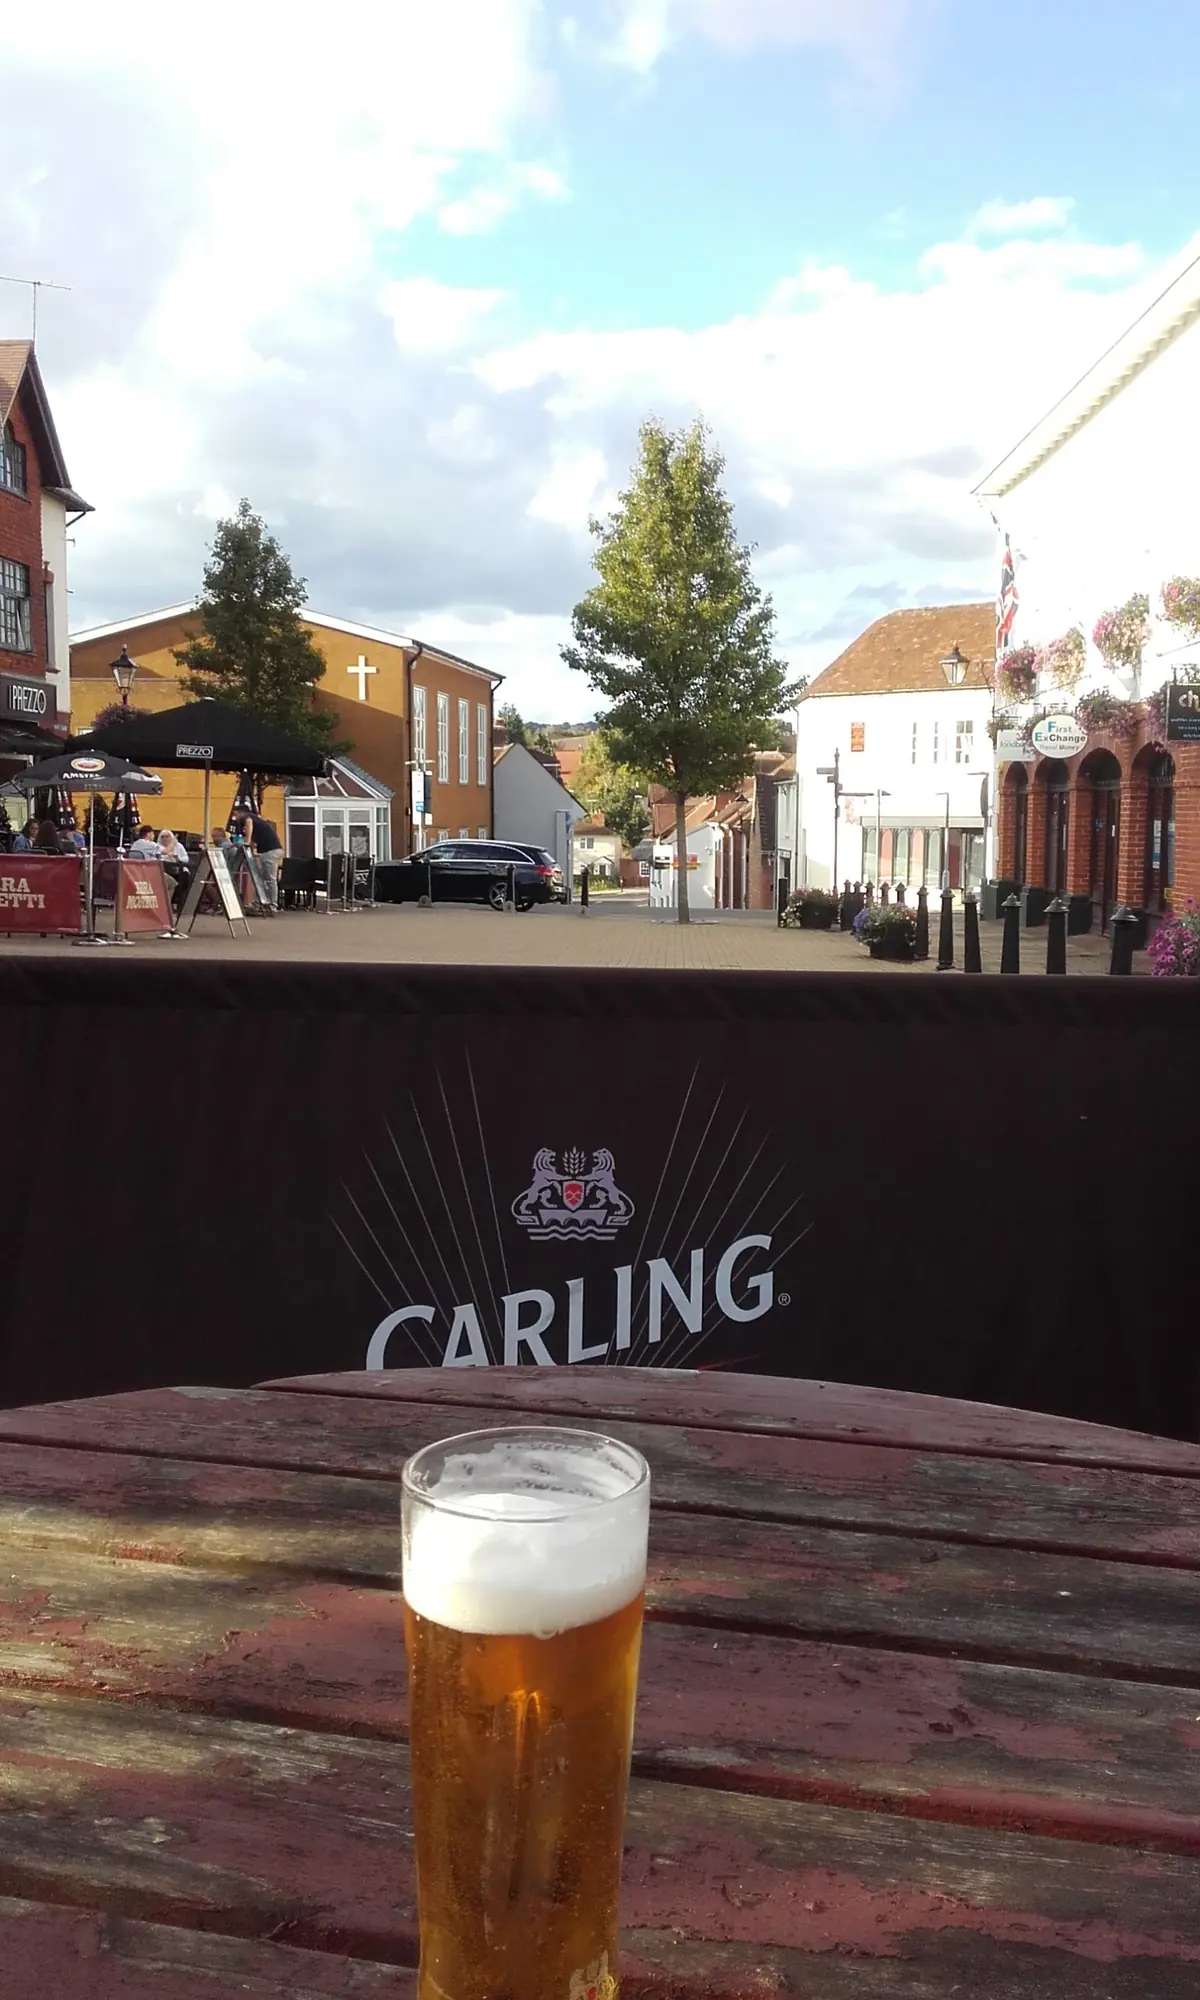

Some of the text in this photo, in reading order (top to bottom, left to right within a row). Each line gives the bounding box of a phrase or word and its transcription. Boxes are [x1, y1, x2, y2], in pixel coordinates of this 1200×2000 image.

[12, 684, 47, 714] PREZZO
[1047, 721, 1072, 733] First
[1034, 732, 1086, 743] ExChange
[178, 746, 212, 757] PREZZO
[365, 1233, 774, 1371] CARLING
